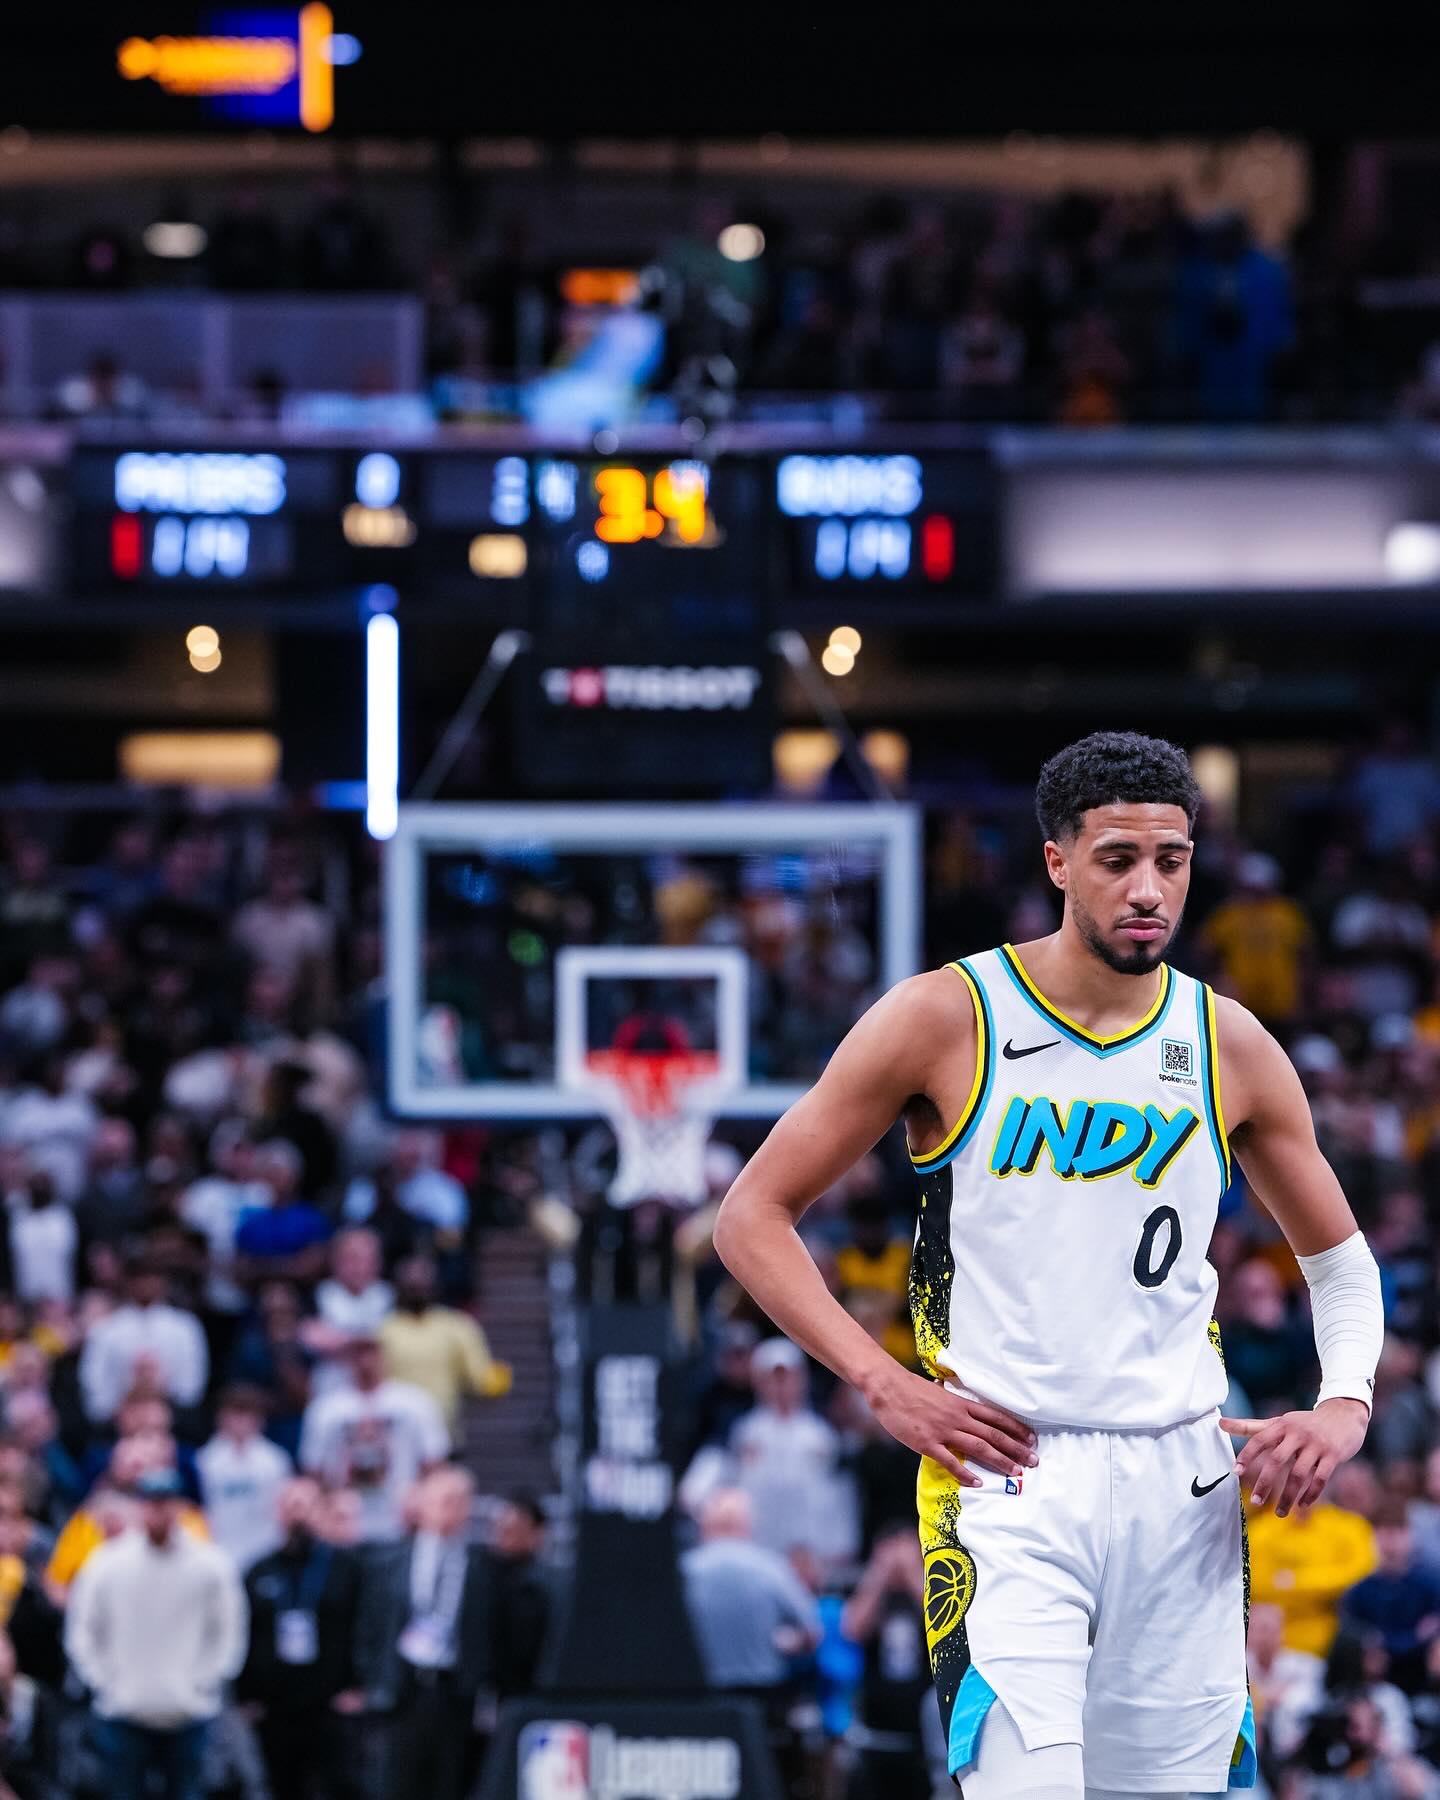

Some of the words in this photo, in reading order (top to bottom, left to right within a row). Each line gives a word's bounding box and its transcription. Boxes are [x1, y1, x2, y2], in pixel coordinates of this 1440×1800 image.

[1158, 1073, 1197, 1086] spokenote
[989, 1094, 1202, 1190] INDY
[1134, 1205, 1182, 1287] 0
